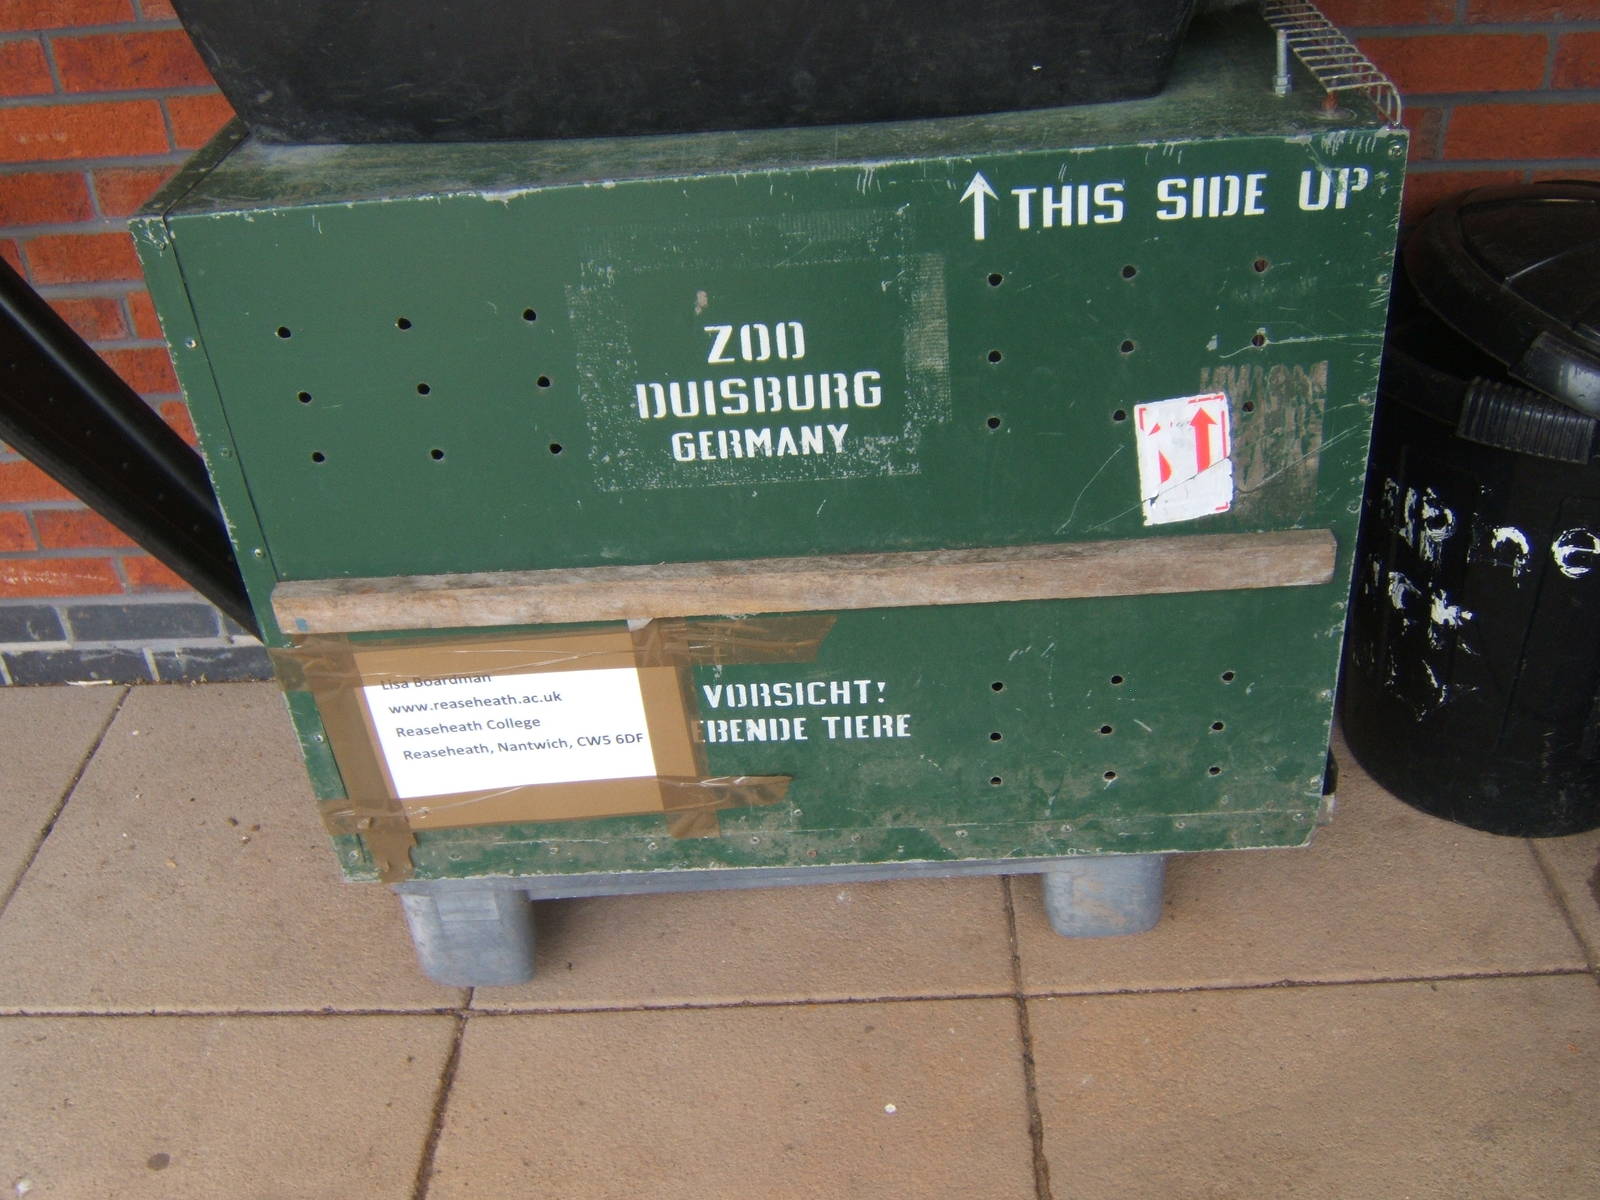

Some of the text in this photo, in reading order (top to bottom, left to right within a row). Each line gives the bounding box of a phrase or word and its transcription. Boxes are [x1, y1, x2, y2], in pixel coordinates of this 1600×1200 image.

[1010, 167, 1369, 230] THIS SIDE UP
[703, 321, 806, 364] ZOO
[636, 370, 882, 419] DUISBURG
[671, 423, 848, 462] GERMANY
[380, 673, 492, 690] Lisa Boardman
[702, 680, 886, 708] VORSICHT!
[389, 691, 562, 714] www.reaseheath.ac.uk
[396, 716, 541, 738] Reaseheath College
[822, 714, 911, 739] TIERE
[403, 732, 644, 761] Reaseheath, Nantwich, CW5 6DF
